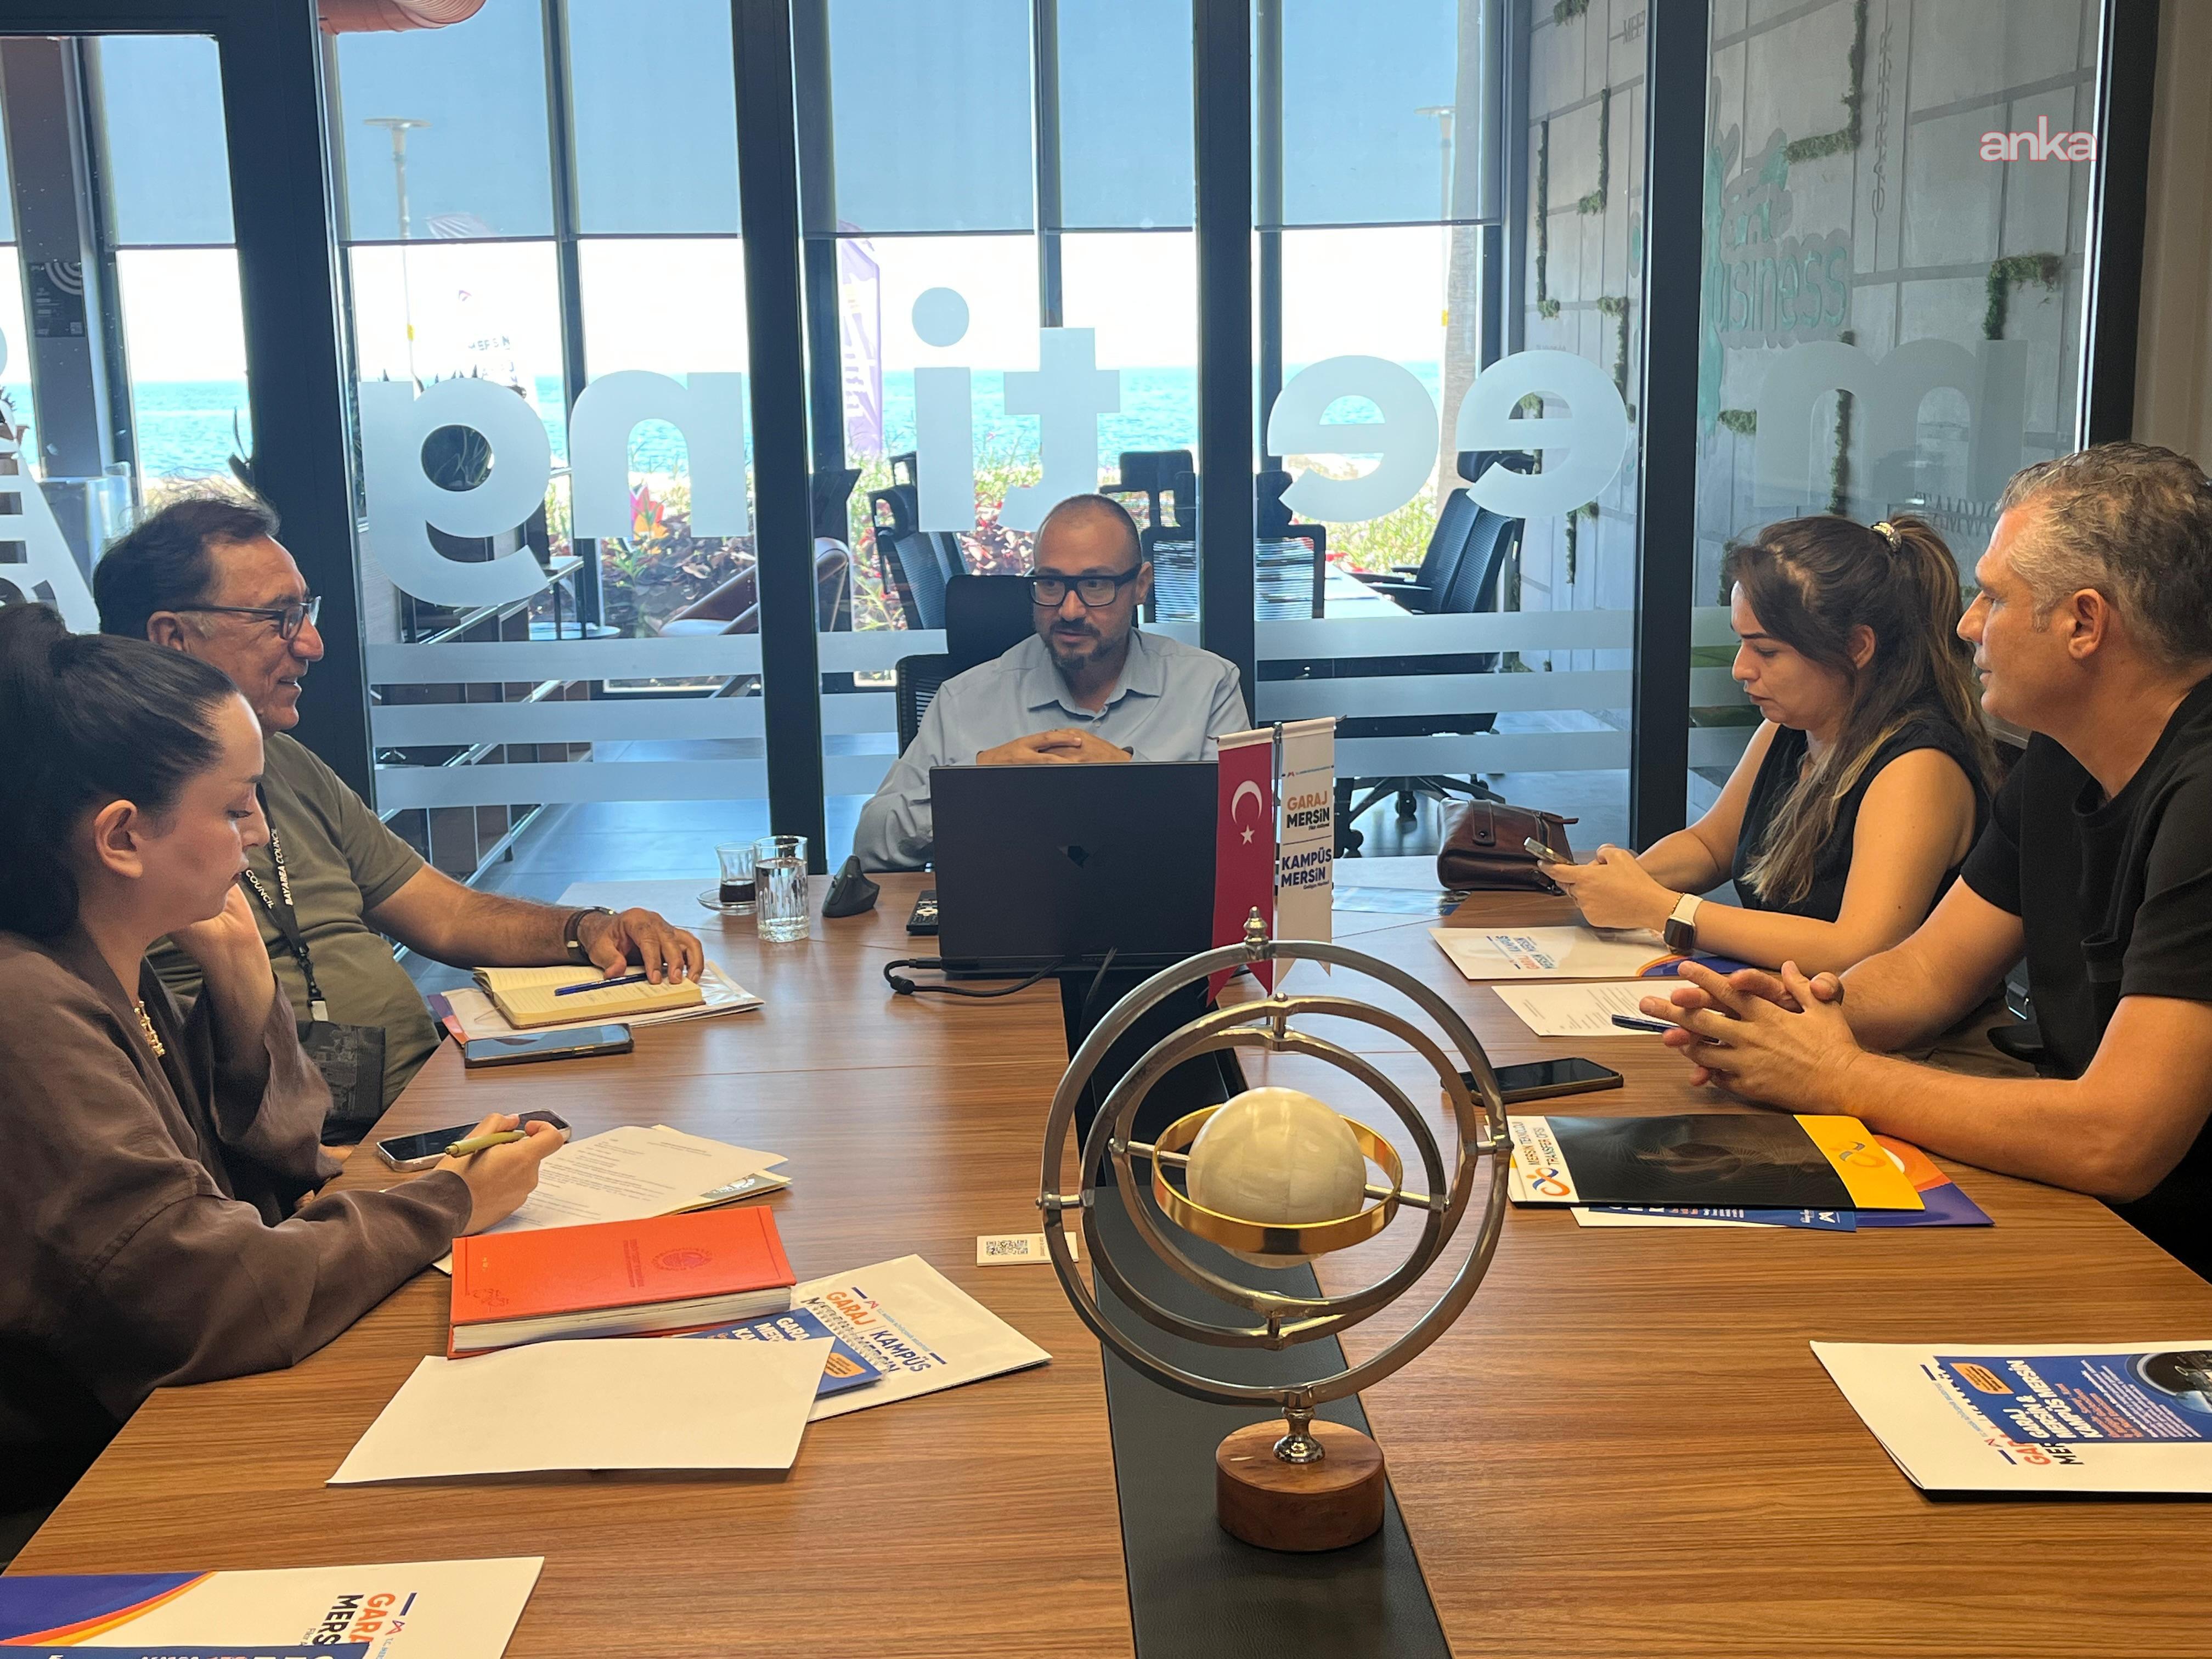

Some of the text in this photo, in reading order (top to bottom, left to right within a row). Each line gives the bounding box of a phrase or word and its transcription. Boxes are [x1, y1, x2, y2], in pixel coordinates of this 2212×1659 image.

[1704, 245, 1849, 332] usiness
[1287, 791, 1327, 811] GARAJ
[1282, 847, 1332, 871] KAMPÜS
[246, 869, 274, 909] COUNCIL
[826, 1291, 876, 1325] GARAJ
[870, 1330, 932, 1372] KAMPÜS
[2016, 1395, 2036, 1403] &
[2044, 1398, 2103, 1438] KAMPÜS
[2002, 1408, 2050, 1438] GARAJ
[312, 1594, 364, 1645] MERS
[348, 1593, 396, 1643] GARA
